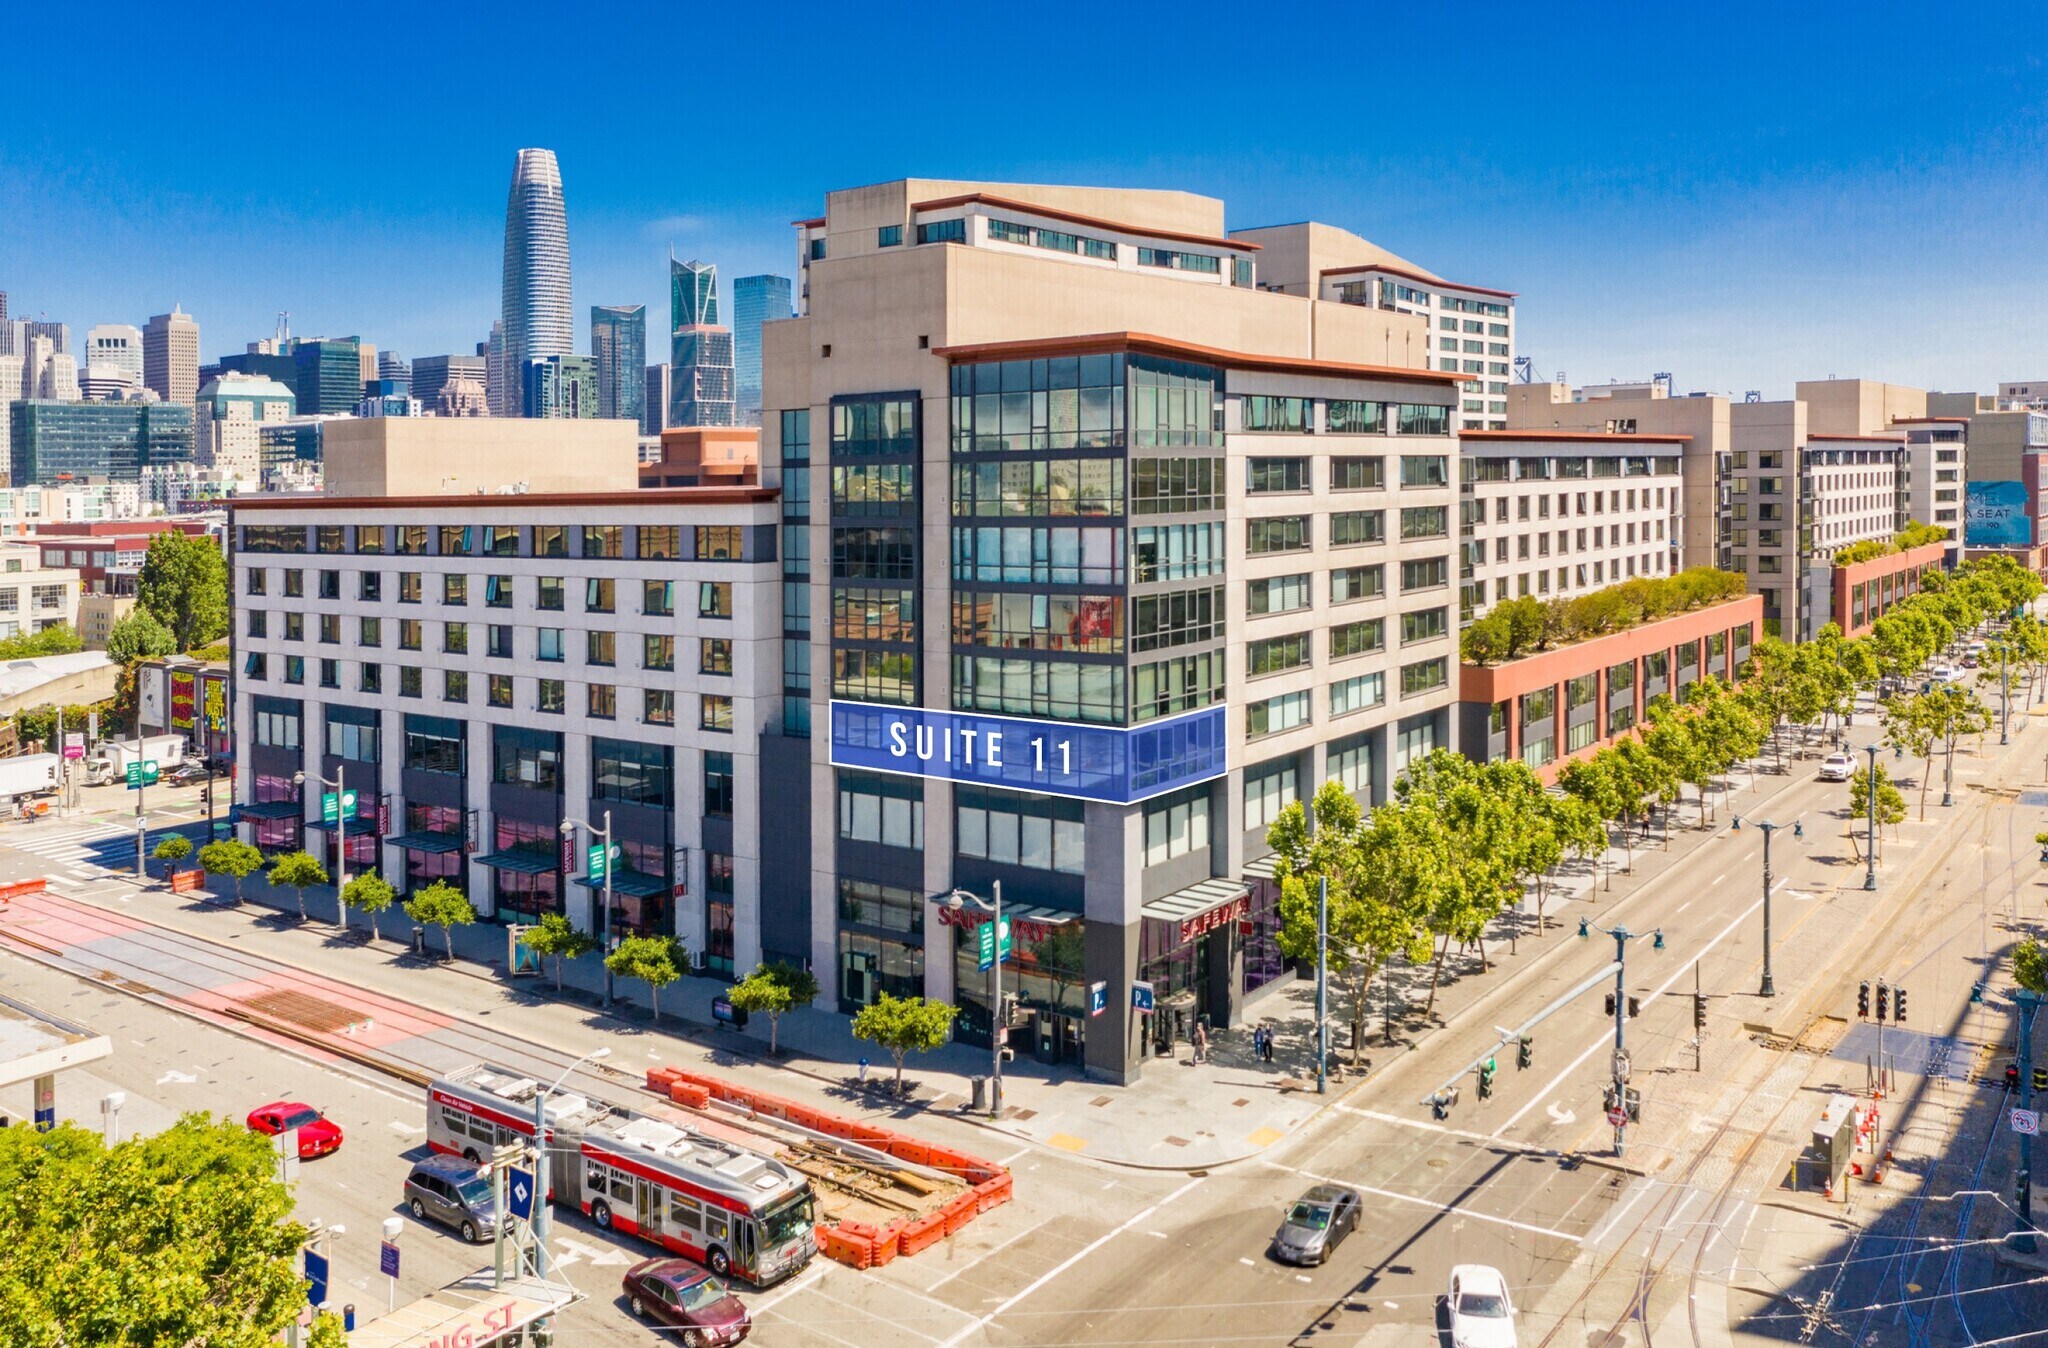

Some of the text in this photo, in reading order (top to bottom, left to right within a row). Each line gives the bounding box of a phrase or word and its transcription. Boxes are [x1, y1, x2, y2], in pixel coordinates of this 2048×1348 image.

[1977, 509, 2011, 519] SEAT
[1985, 521, 2000, 530] 190
[205, 701, 225, 717] MUST
[1181, 895, 1250, 942] SAFEWAY
[1135, 990, 1141, 1006] P
[482, 1301, 517, 1337] ST
